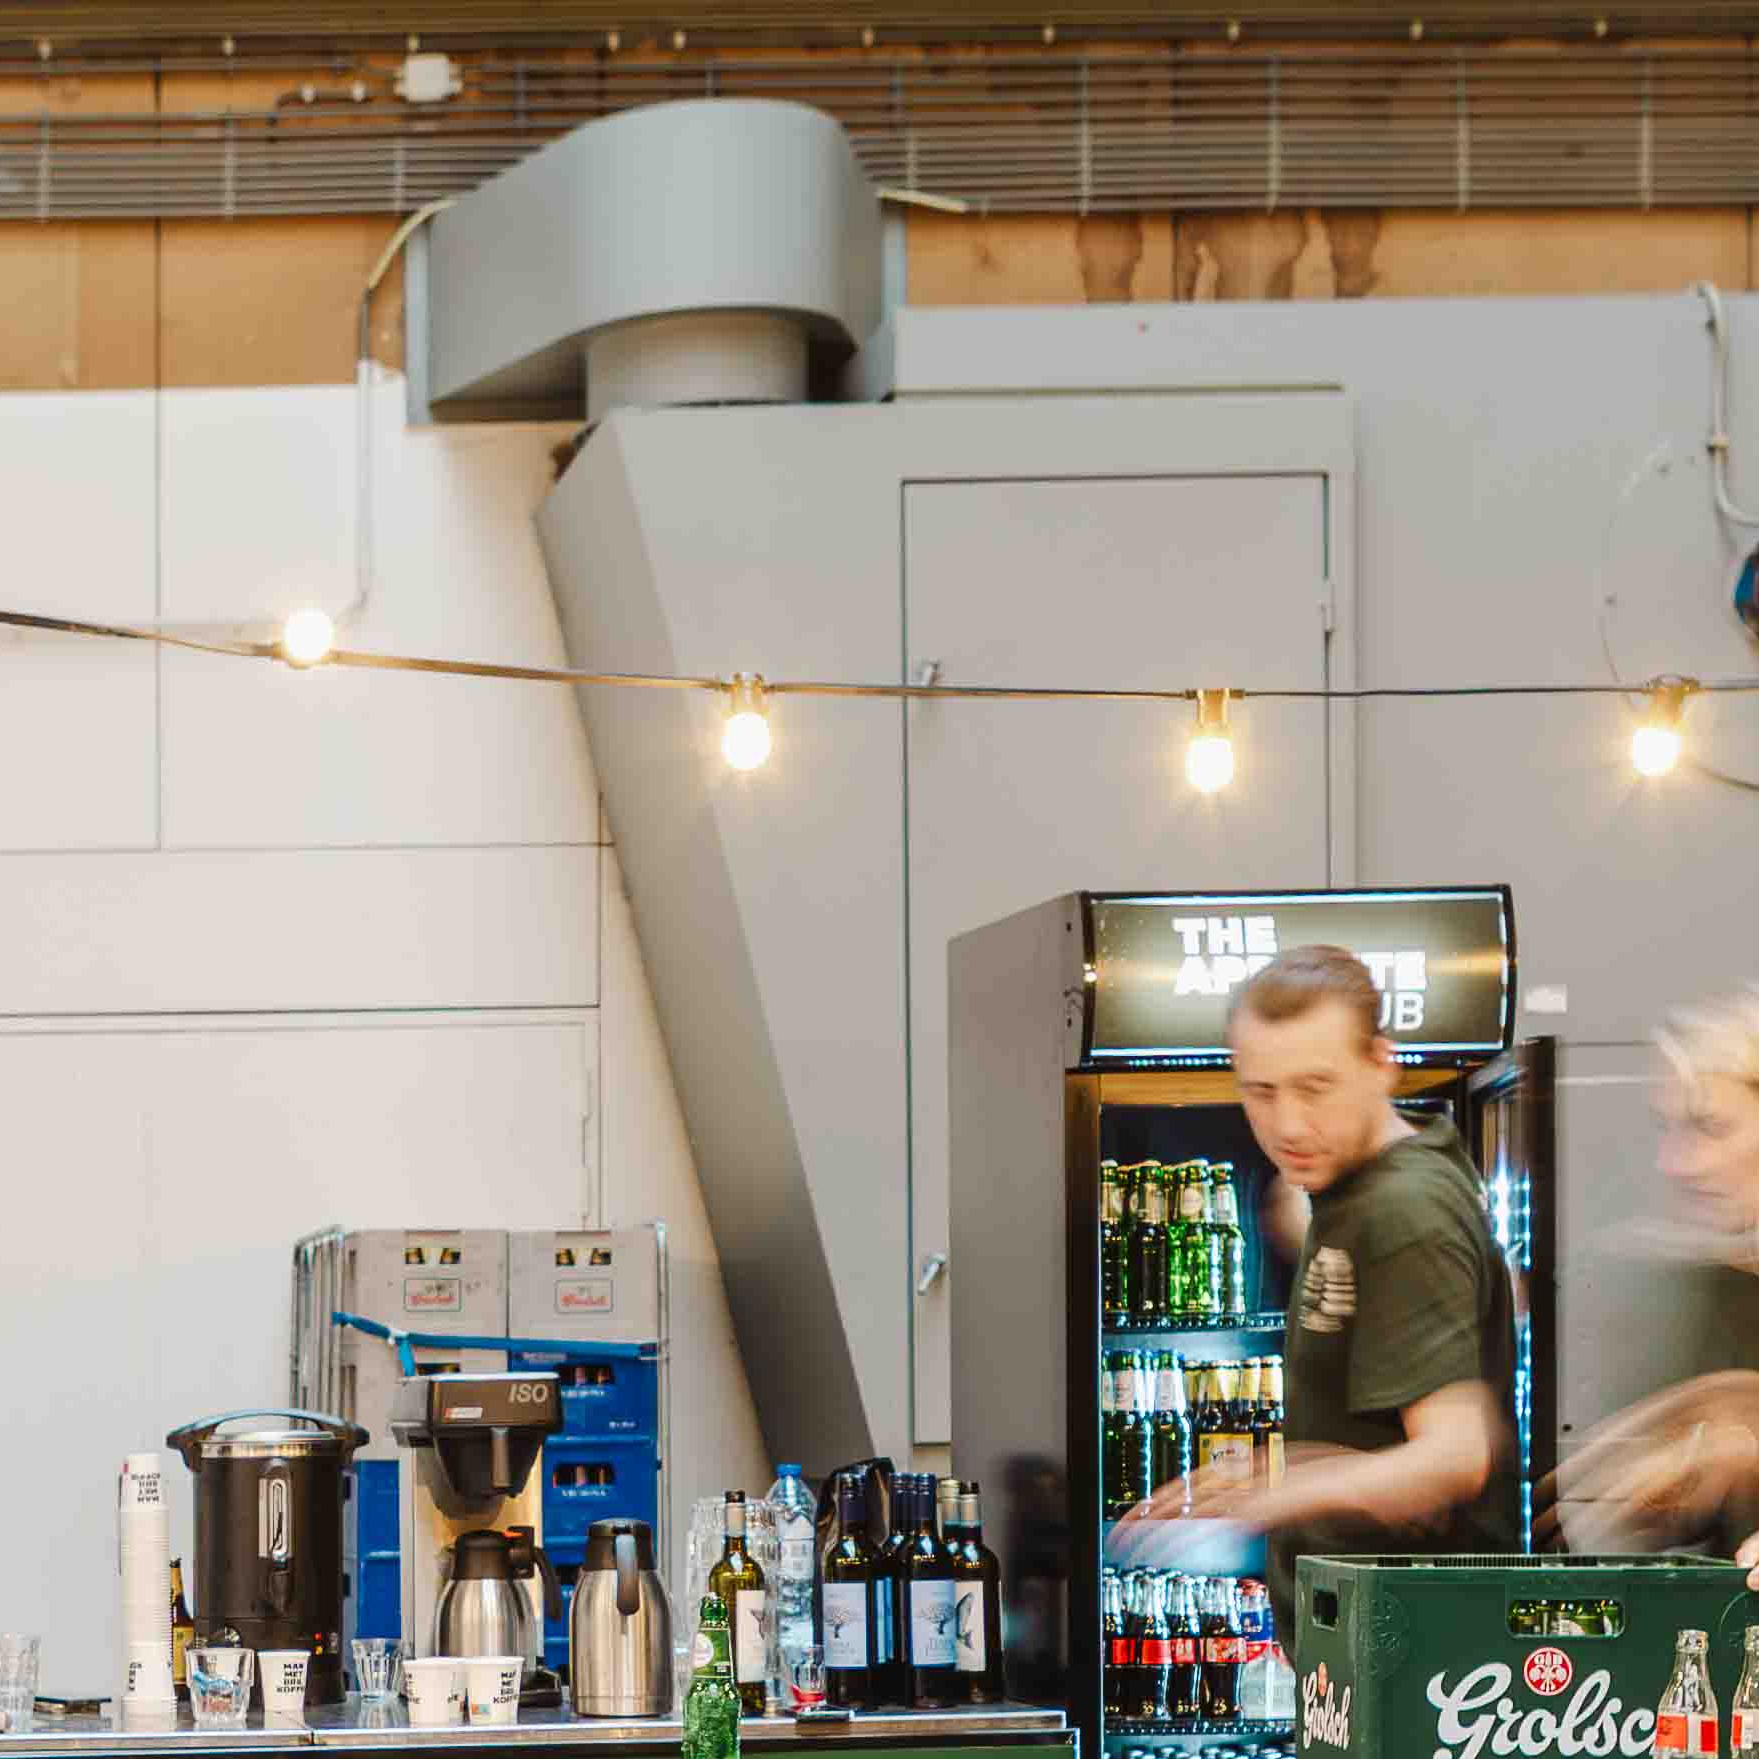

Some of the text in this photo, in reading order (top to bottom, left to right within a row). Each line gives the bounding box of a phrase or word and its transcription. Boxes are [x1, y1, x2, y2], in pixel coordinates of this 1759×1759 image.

[1173, 915, 1277, 954] THE
[508, 1383, 548, 1403] ISO
[1302, 1671, 1351, 1751] Grolsch
